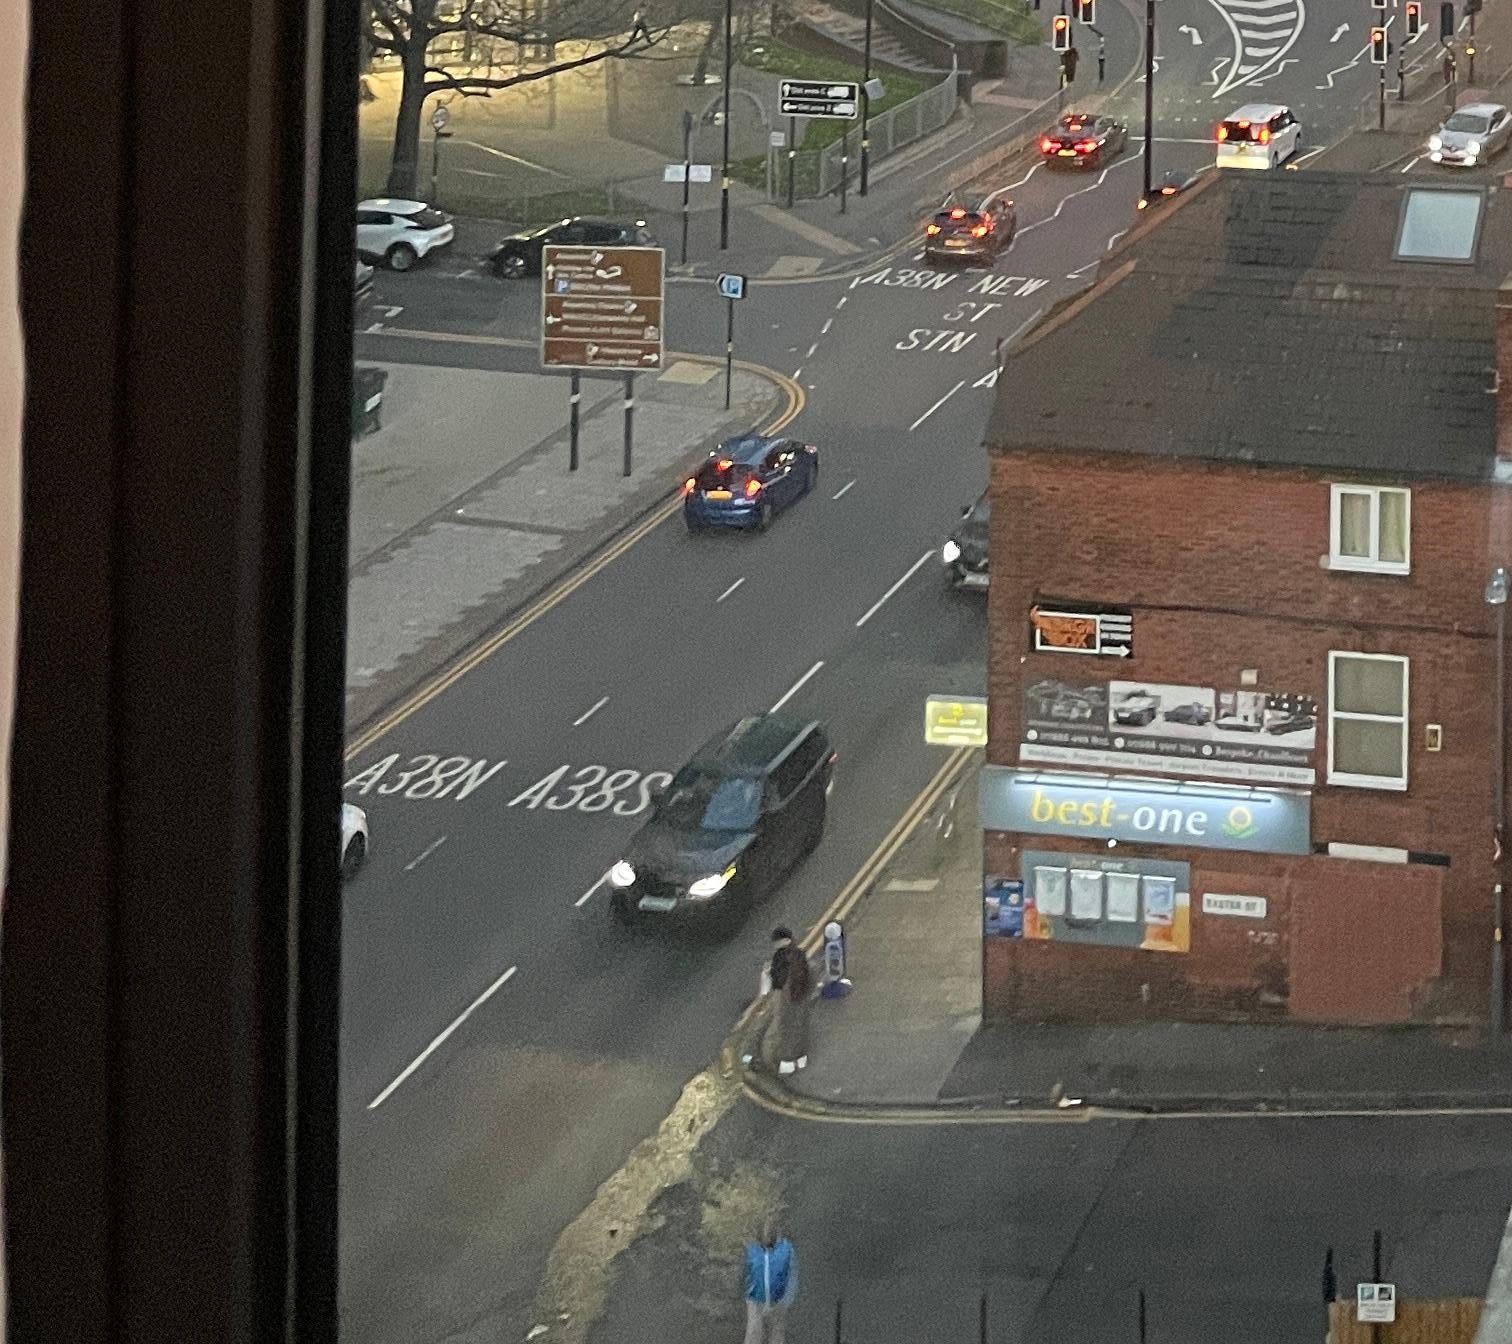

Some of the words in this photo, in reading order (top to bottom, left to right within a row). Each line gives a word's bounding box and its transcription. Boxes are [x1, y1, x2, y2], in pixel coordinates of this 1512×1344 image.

[967, 274, 1050, 297] NEW
[943, 301, 1003, 322] ST
[896, 327, 977, 353] STN
[343, 753, 508, 802] A38N
[507, 764, 674, 816] A38S
[1030, 789, 1208, 836] best-one
